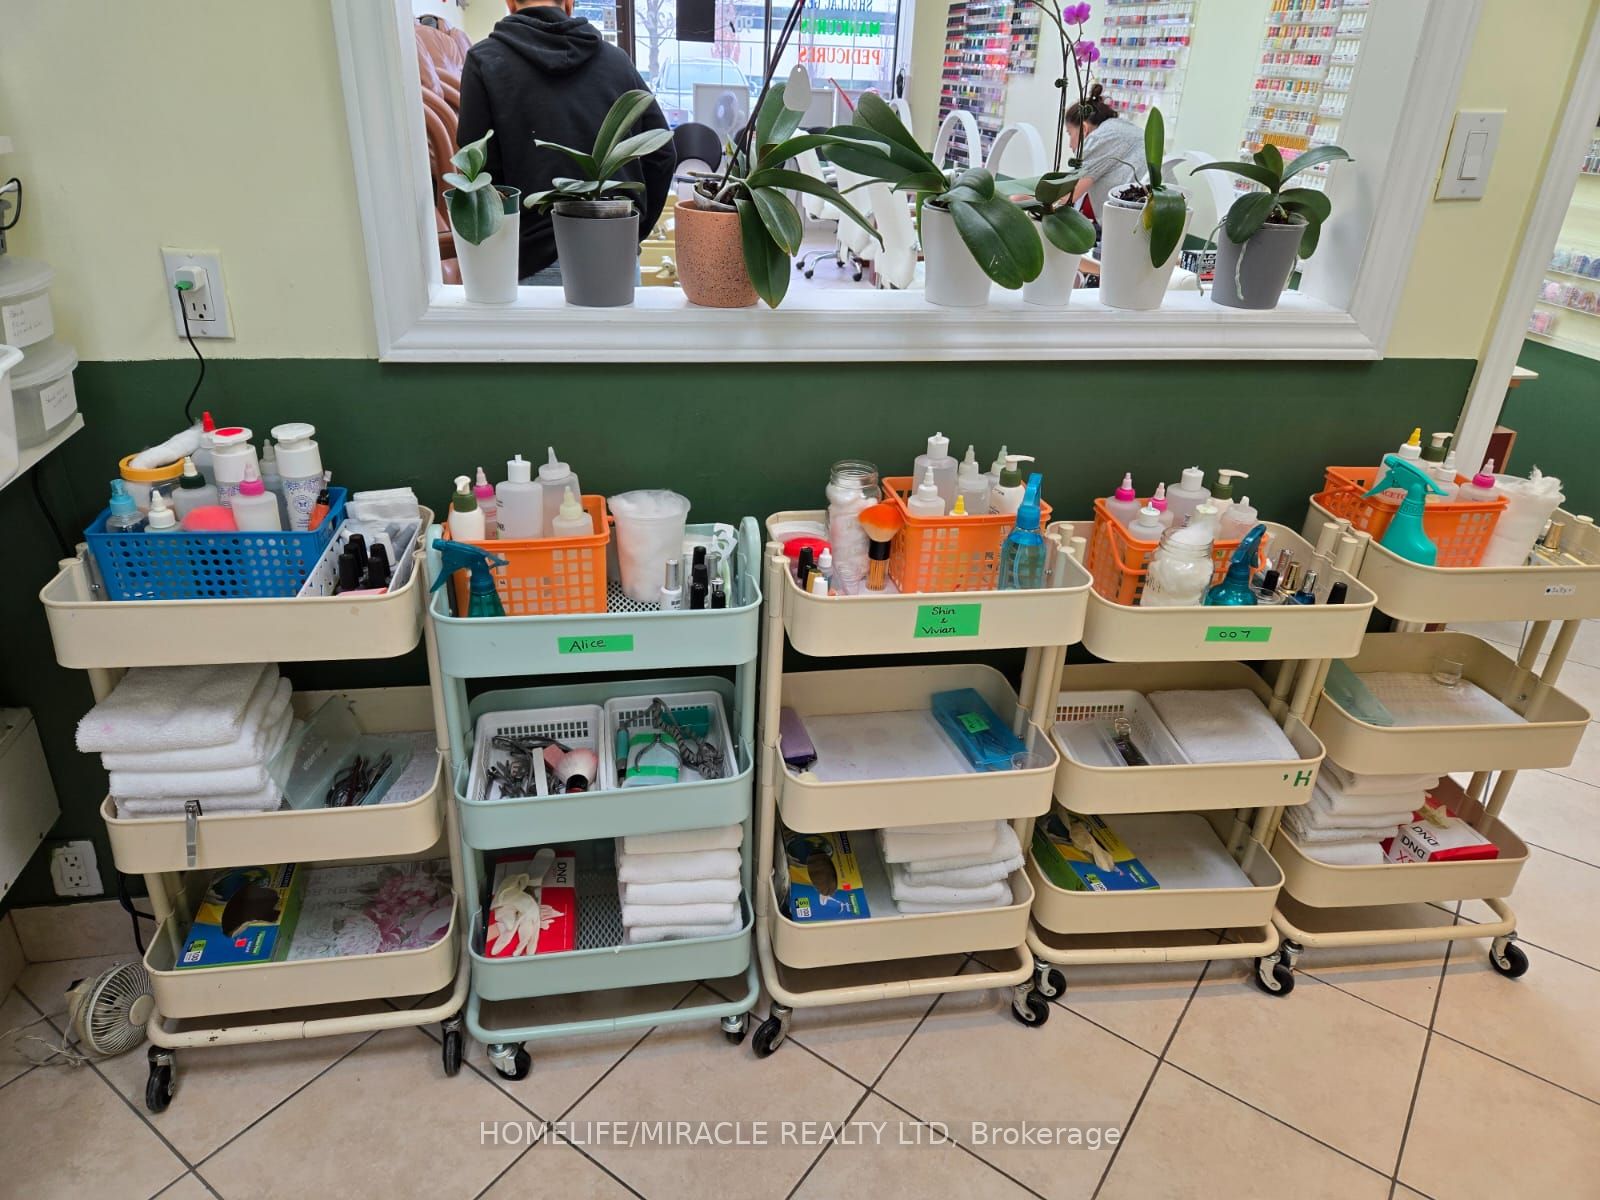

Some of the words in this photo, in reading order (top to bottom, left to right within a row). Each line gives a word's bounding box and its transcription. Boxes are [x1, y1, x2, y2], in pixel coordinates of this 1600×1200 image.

[931, 606, 956, 616] Shin
[921, 626, 957, 634] Vivian
[568, 637, 606, 651] Alice
